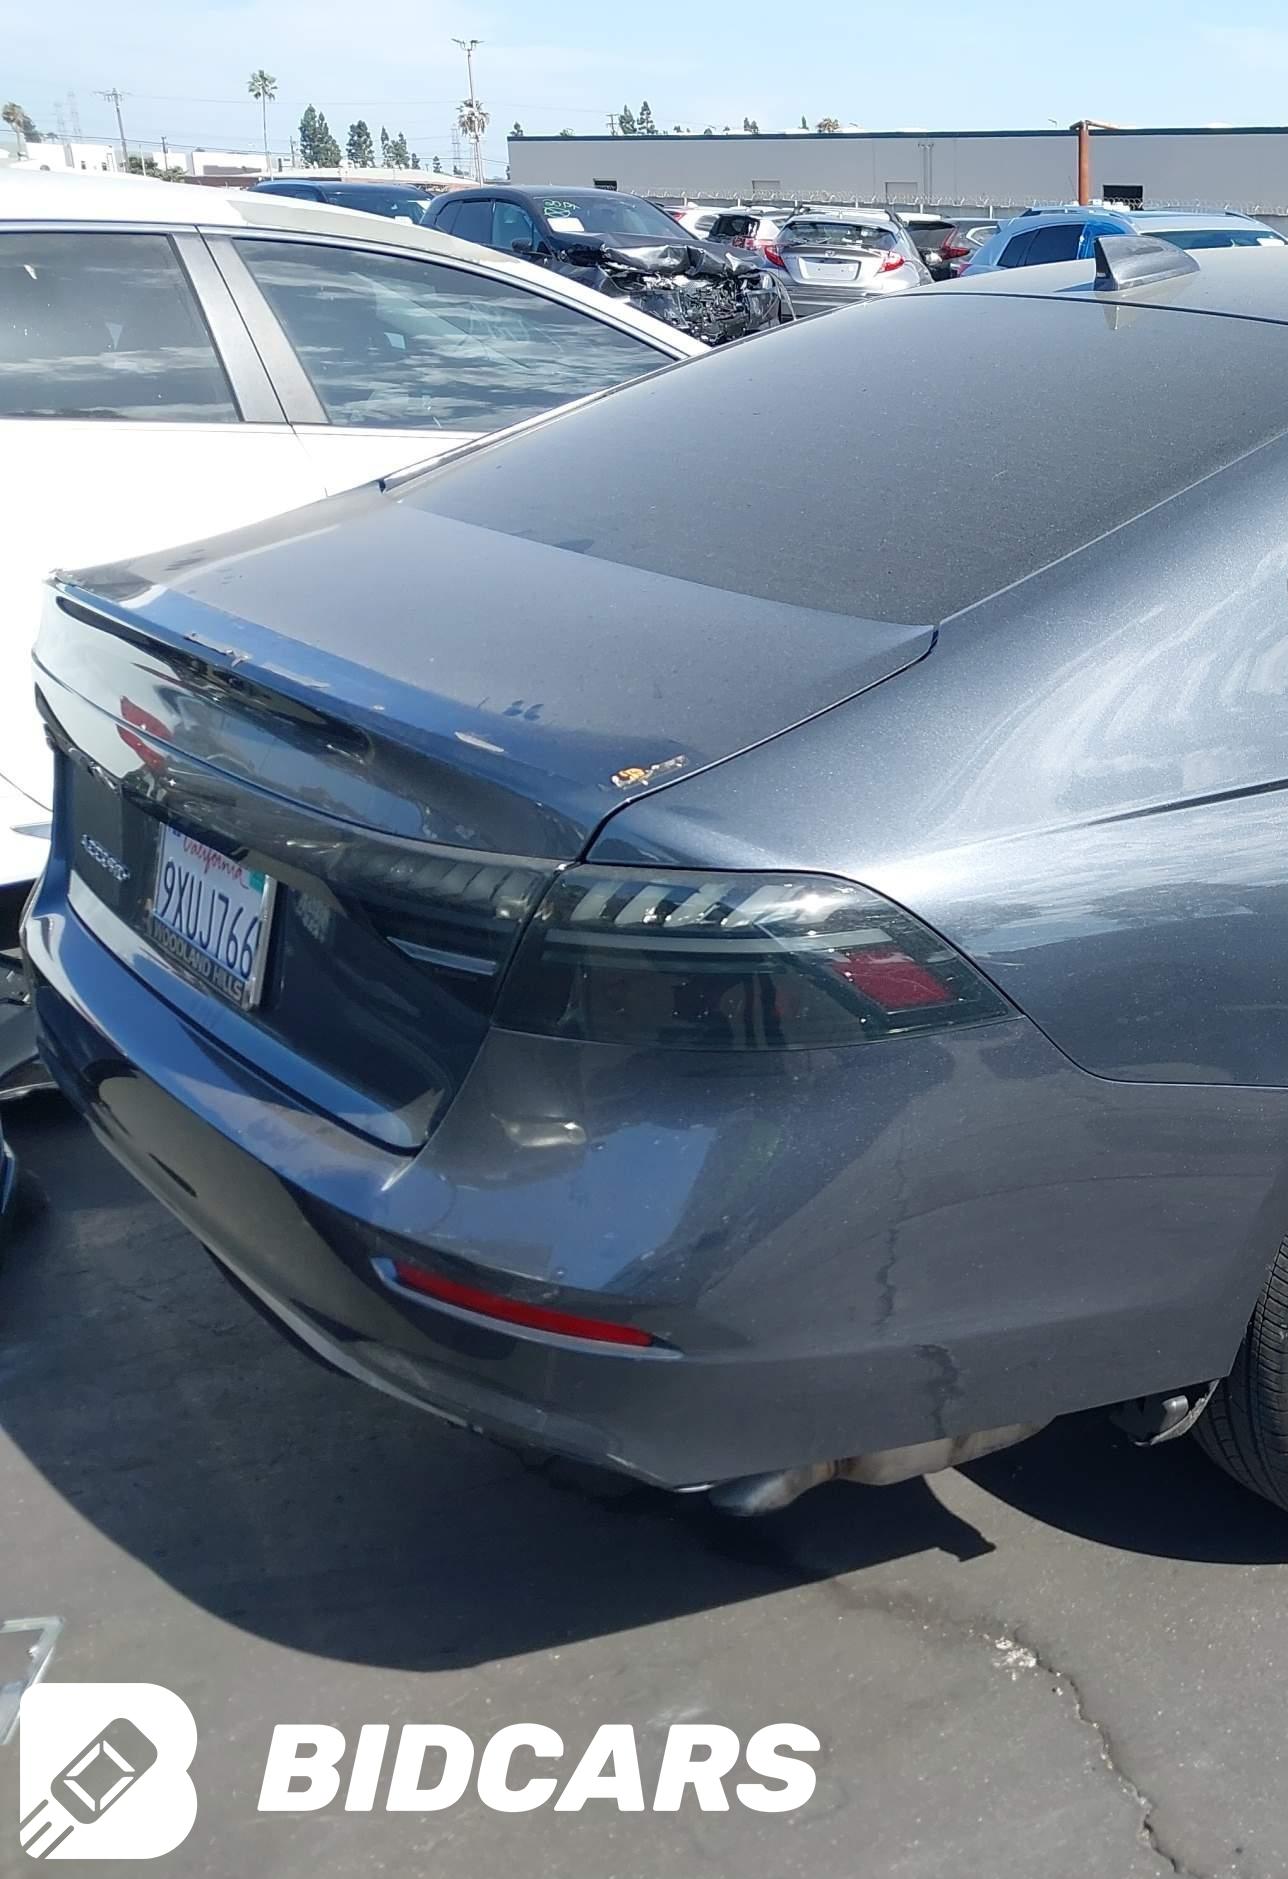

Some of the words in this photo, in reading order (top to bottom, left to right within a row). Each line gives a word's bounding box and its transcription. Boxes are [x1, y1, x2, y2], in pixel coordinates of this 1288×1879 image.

[151, 923, 211, 976] WOODLAND
[211, 957, 243, 1000] HILLS
[161, 860, 259, 980] 9XUJ766
